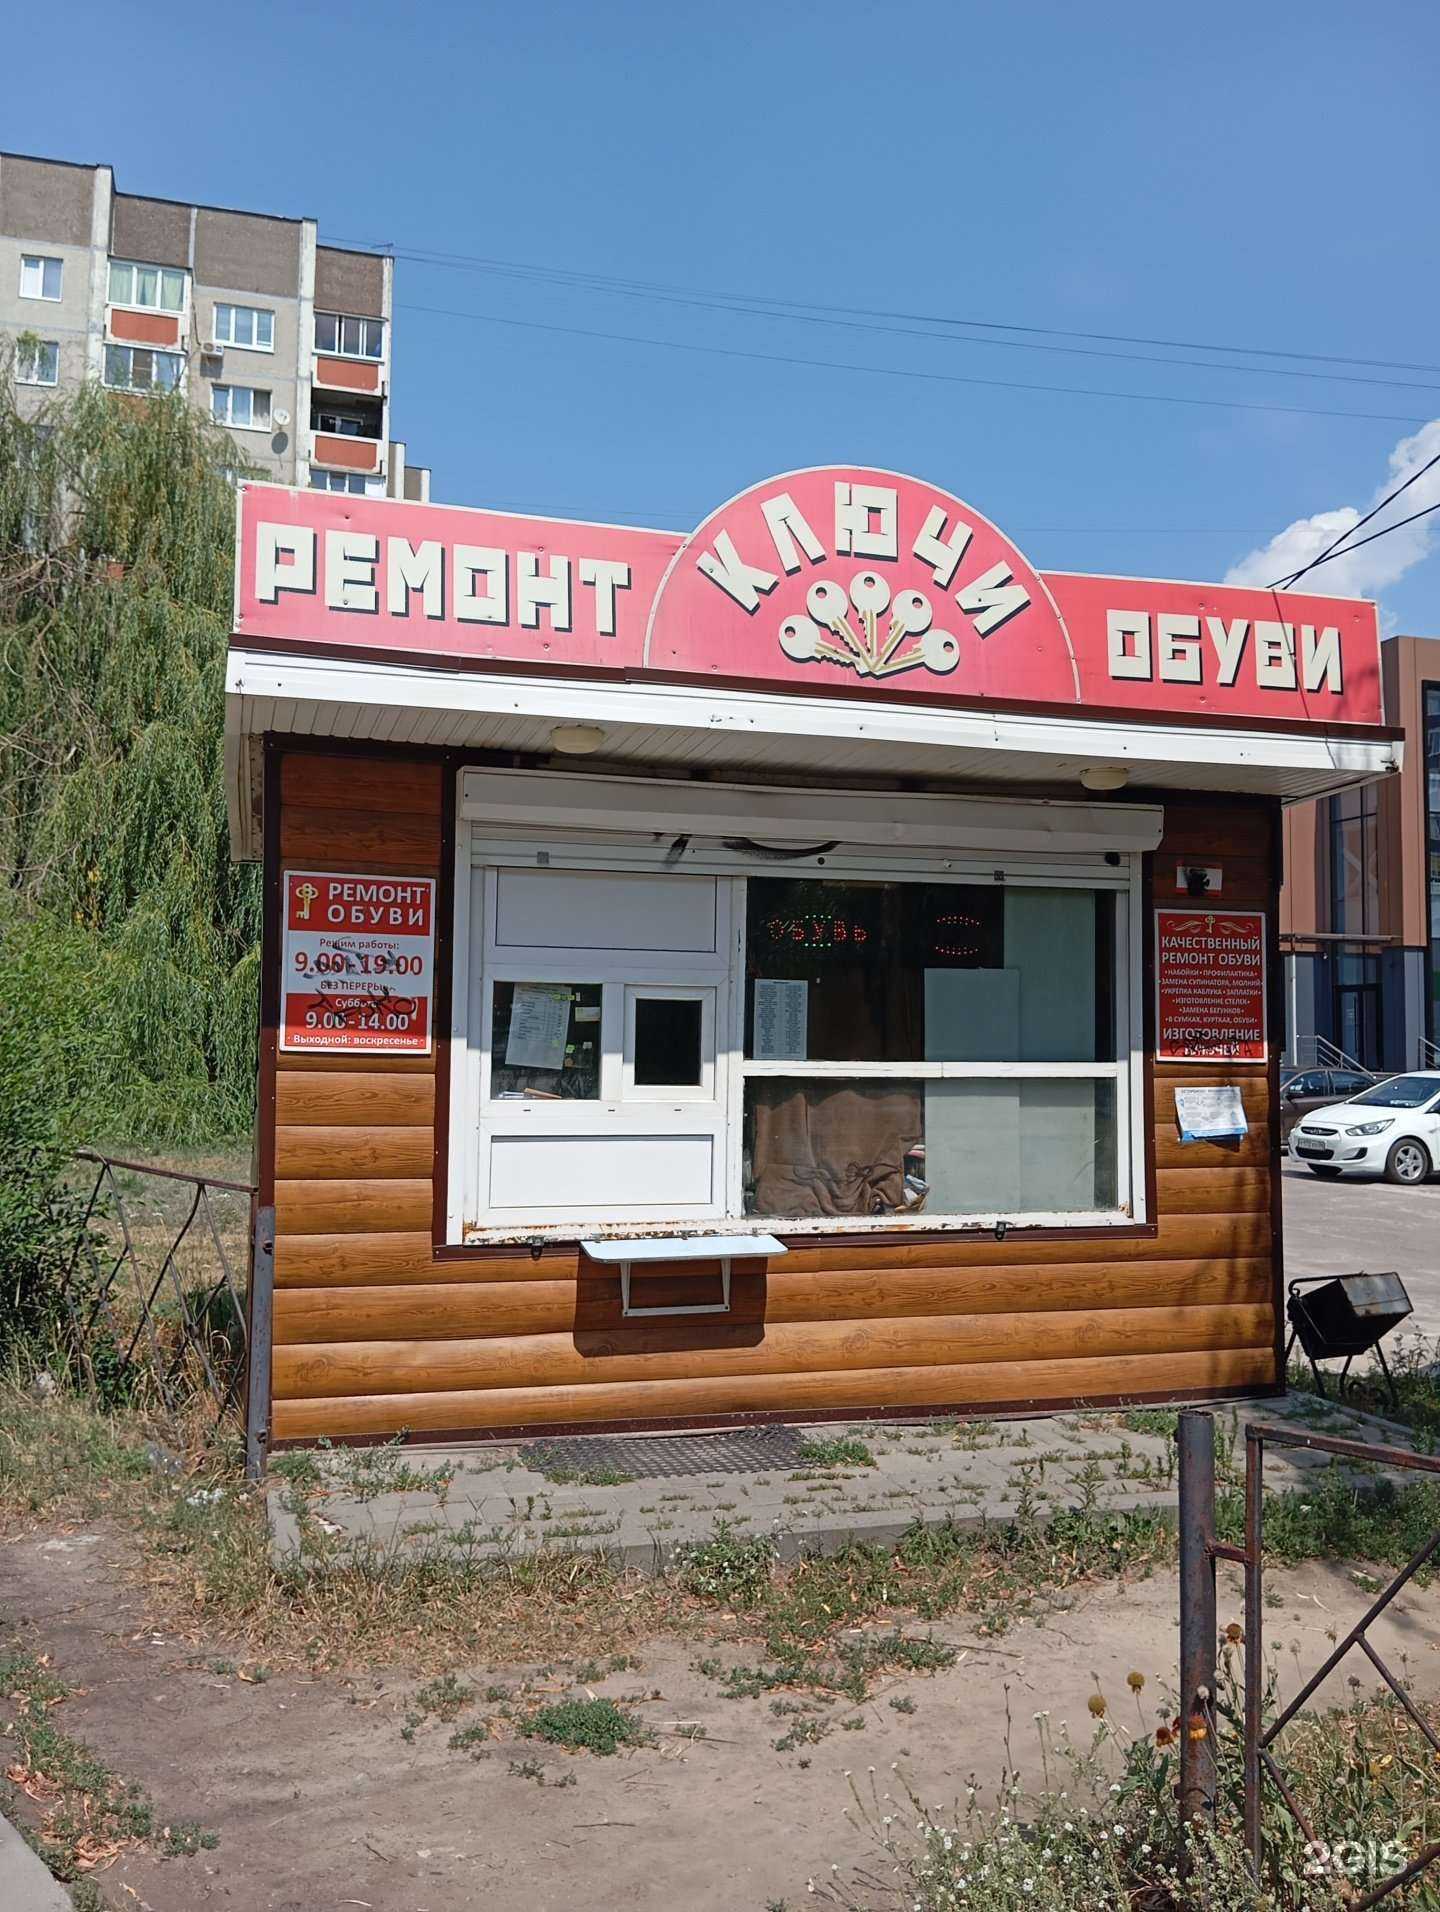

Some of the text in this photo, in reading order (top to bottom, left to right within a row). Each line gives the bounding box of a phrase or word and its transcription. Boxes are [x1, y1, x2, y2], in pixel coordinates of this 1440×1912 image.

[696, 481, 1031, 639] КЛЮЧИ
[255, 521, 1343, 695] РЕМОНТ ОБУВИ
[328, 883, 425, 904] РЕМОНТ
[328, 905, 423, 926] ОБУВИ
[358, 940, 400, 952] работы:
[1161, 935, 1260, 951] КАЧЕСТВЕННЫЙ
[1162, 952, 1261, 966] РЕМОНТ ОБУВИ
[1203, 969, 1254, 977] ПРОФИЛАКТИКА
[293, 1034, 418, 1047] Выходной: воскресенье
